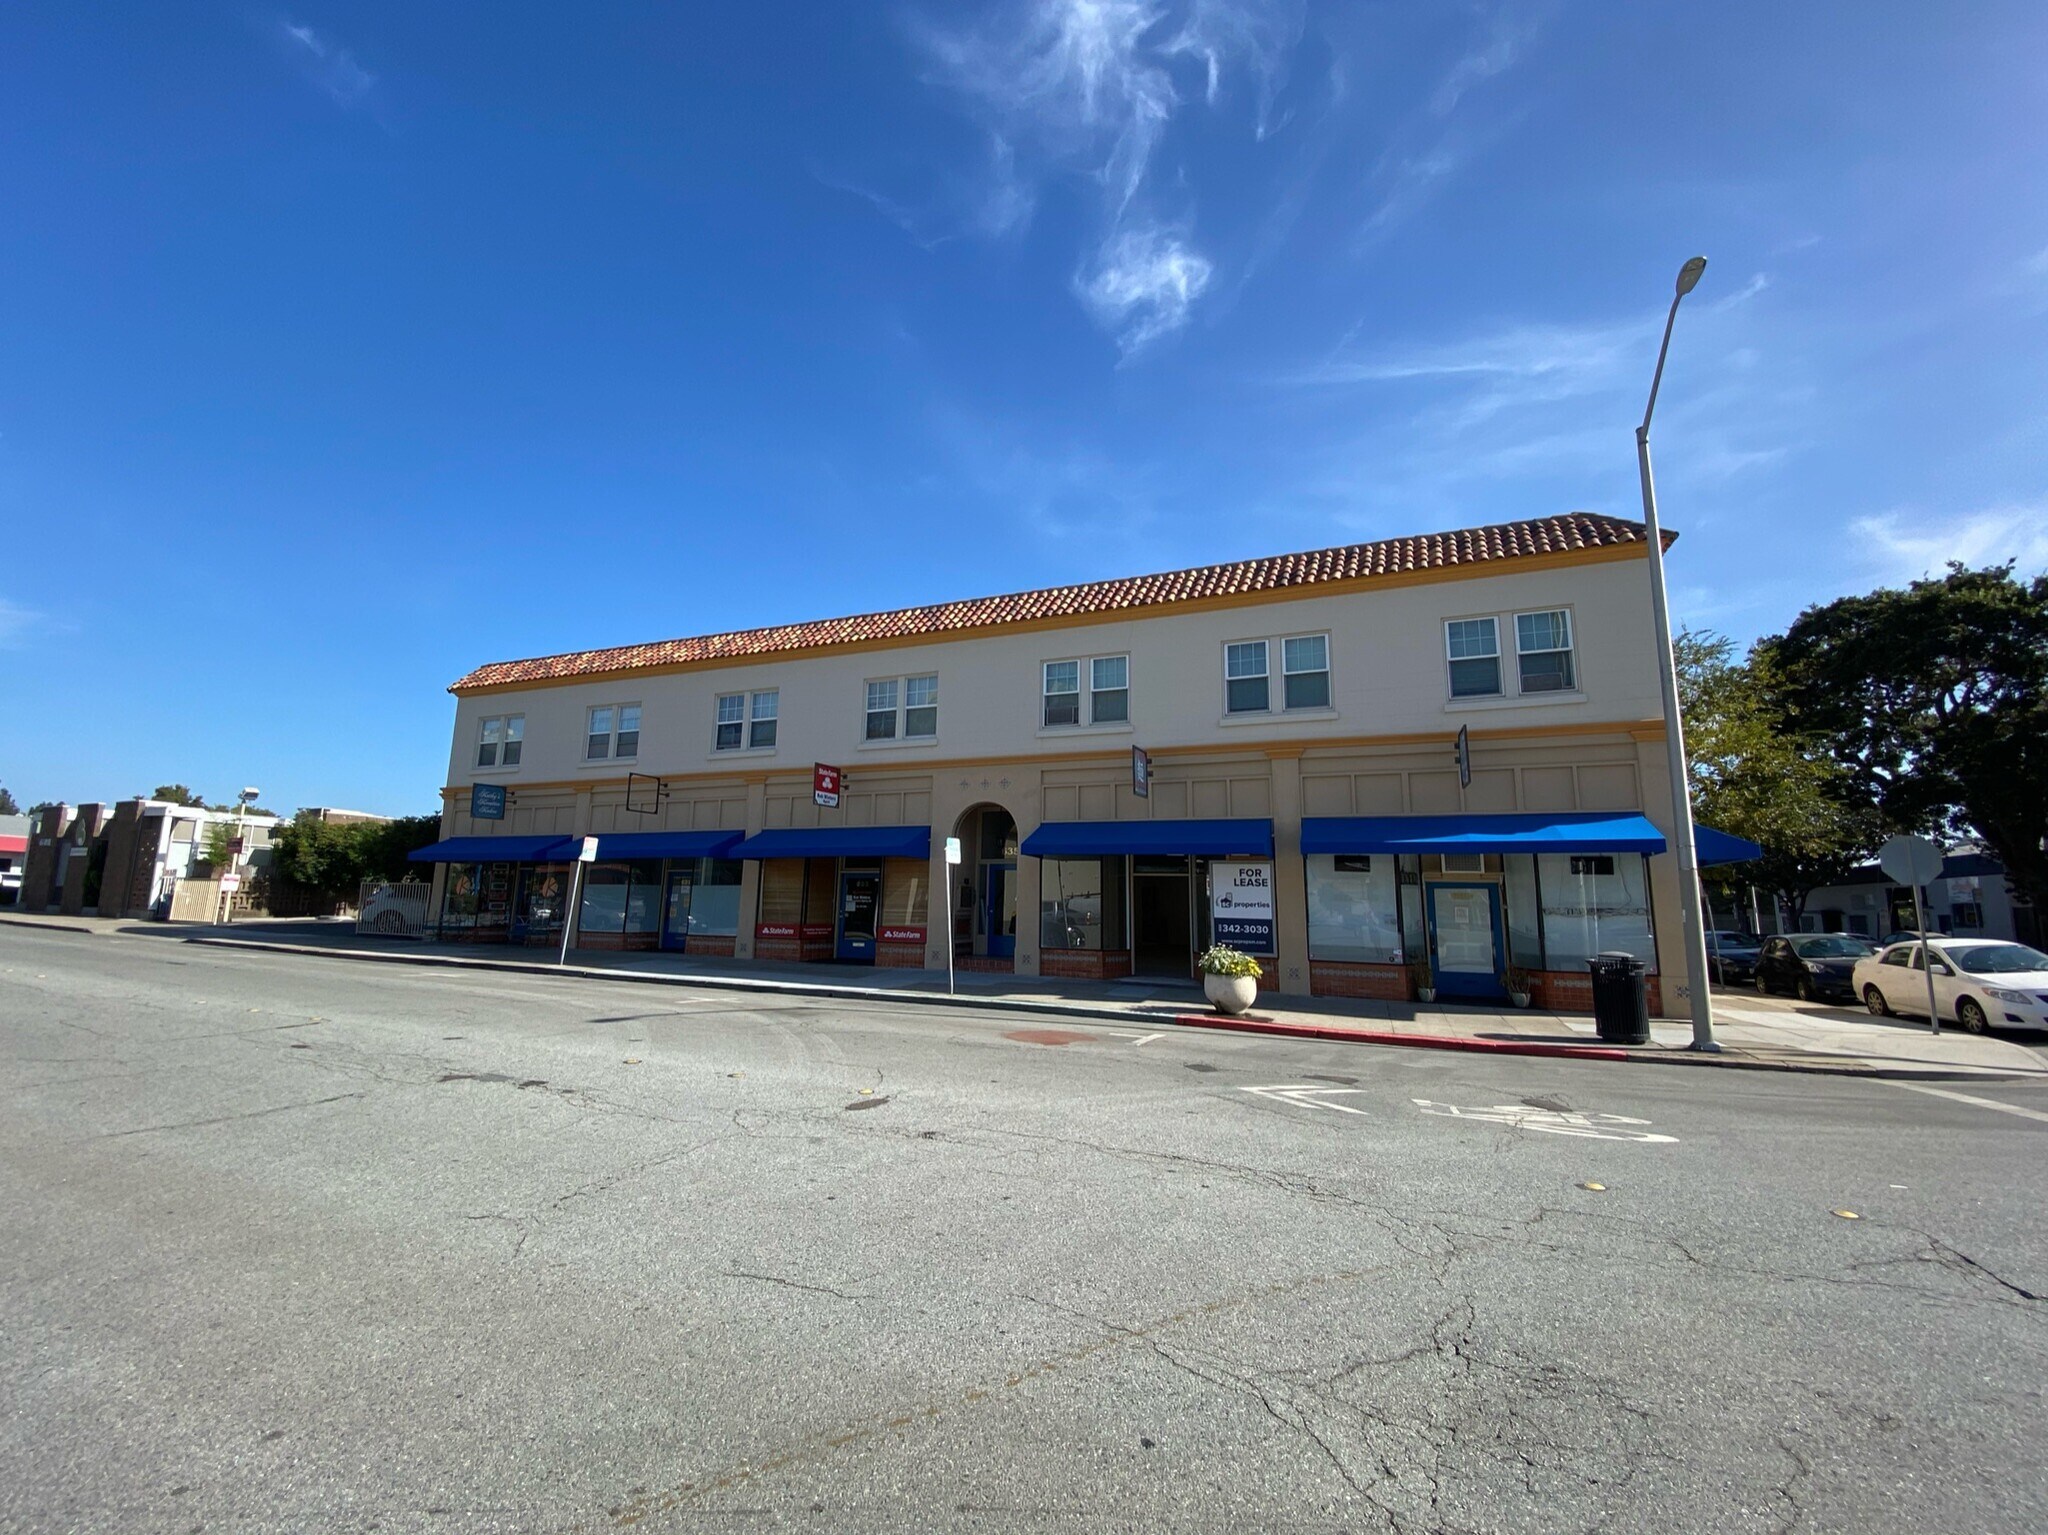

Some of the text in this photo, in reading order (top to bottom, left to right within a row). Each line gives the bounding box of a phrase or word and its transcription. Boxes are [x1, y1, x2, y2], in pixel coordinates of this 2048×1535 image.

[1239, 868, 1262, 877] FOR
[1234, 878, 1268, 887] LEASE
[1234, 901, 1270, 909] properties
[1222, 924, 1269, 934] 342-3030
